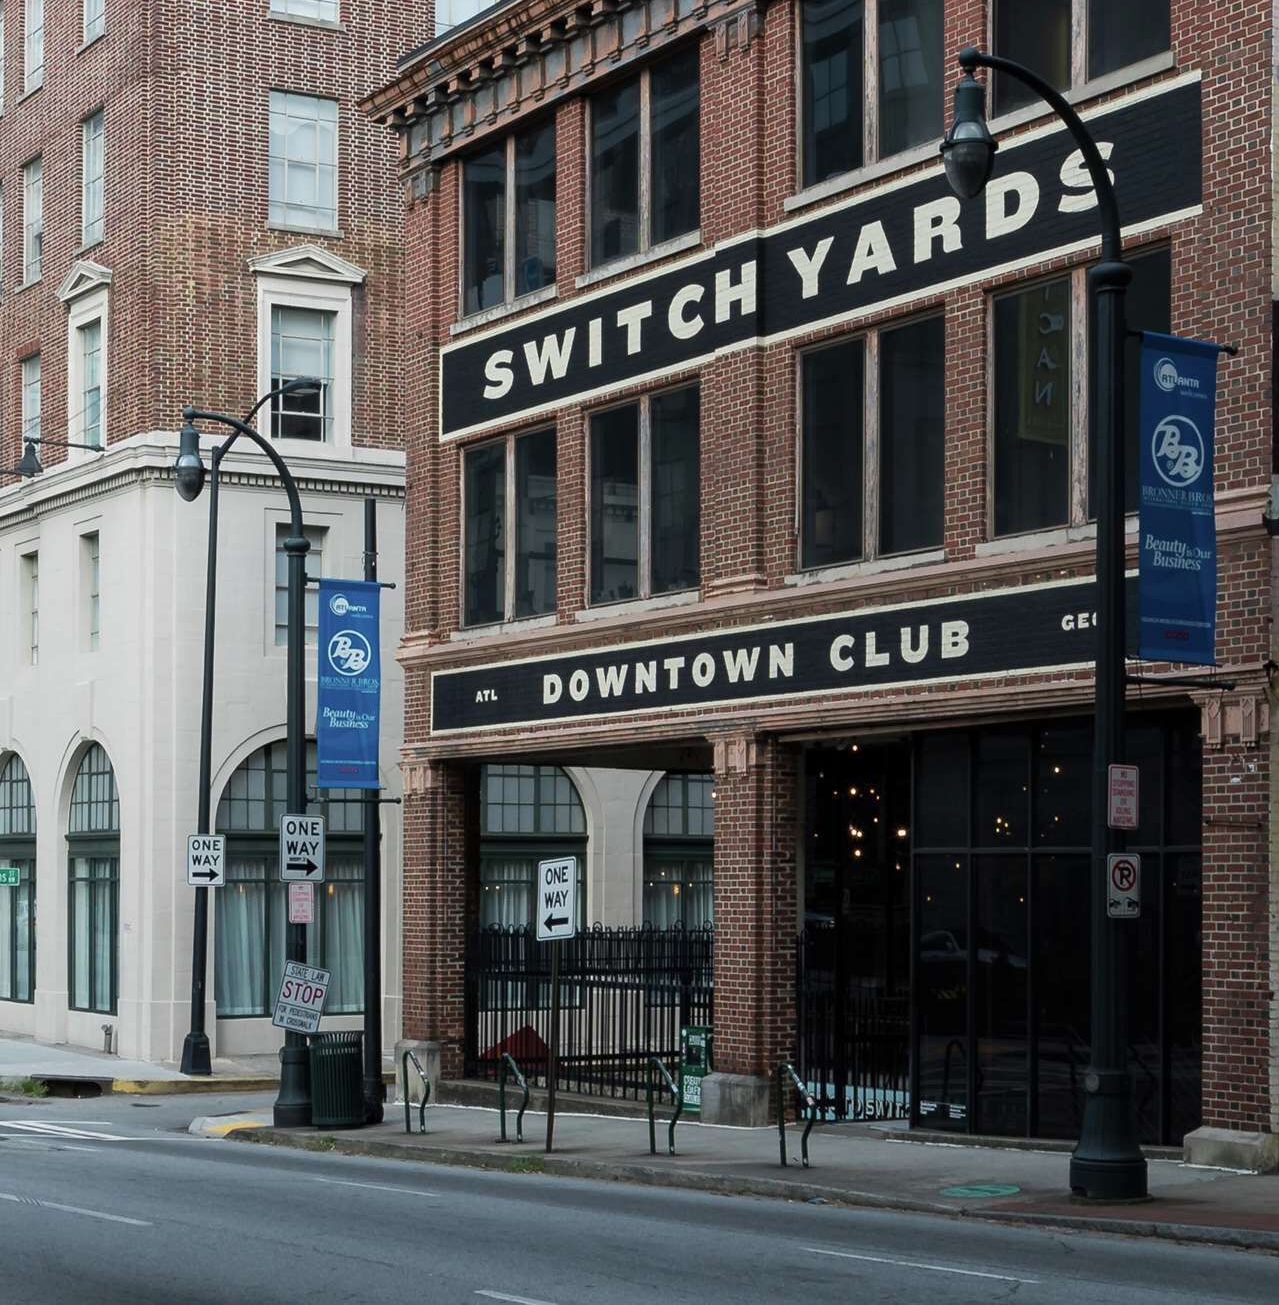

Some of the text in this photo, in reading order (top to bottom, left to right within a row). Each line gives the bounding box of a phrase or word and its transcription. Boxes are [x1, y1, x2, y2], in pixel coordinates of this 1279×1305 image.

[482, 139, 1118, 401] SWITCH YARDS
[1144, 534, 1186, 558] Beauty
[1192, 547, 1213, 559] Our
[1153, 550, 1201, 571] Business
[474, 688, 499, 704] ATL
[543, 642, 796, 707] DOWNTOWN
[829, 620, 972, 673] CLUB
[322, 707, 356, 721] Beauty
[329, 717, 369, 729] Business
[287, 820, 320, 836] ONE
[192, 839, 221, 851] ONE
[287, 840, 320, 856] WAY
[192, 854, 220, 866] WAY
[545, 864, 569, 886] ONE
[544, 889, 569, 910] WAY
[290, 965, 326, 983] STATE LAW
[282, 980, 324, 1005] STOP
